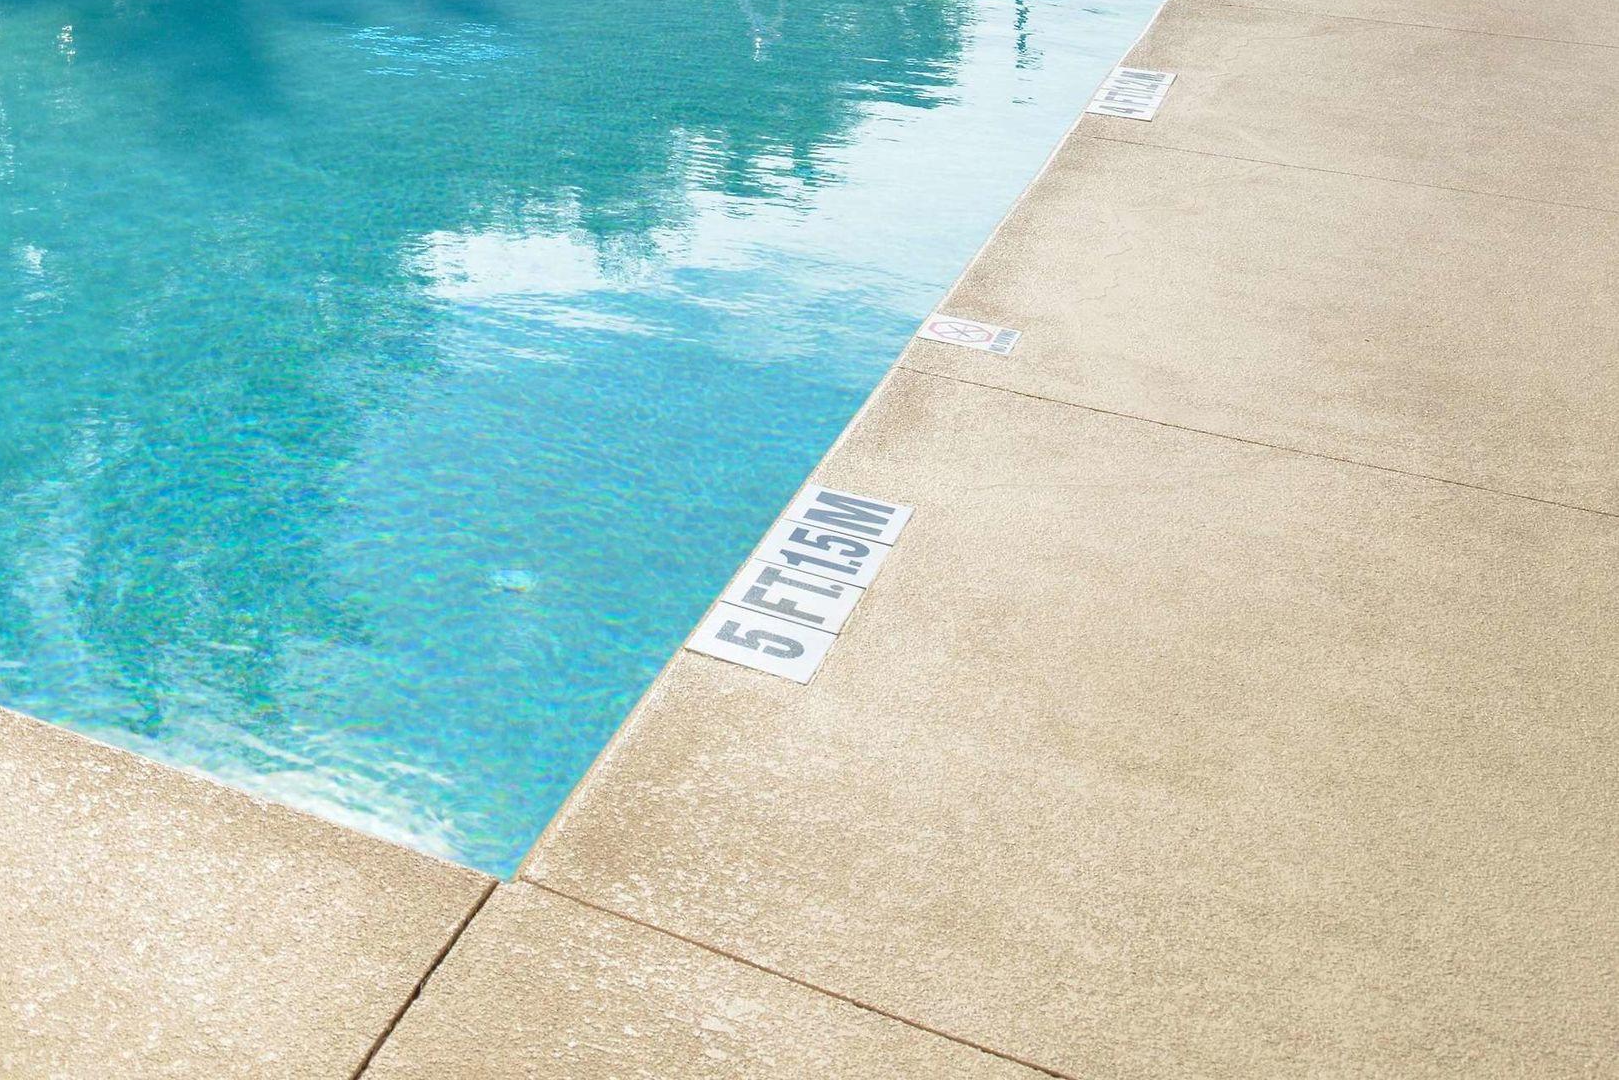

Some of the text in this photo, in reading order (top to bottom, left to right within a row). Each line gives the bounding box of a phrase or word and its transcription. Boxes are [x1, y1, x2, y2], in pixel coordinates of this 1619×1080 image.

[803, 490, 897, 537] M
[779, 527, 871, 576] 1.5
[715, 619, 805, 660] 5
